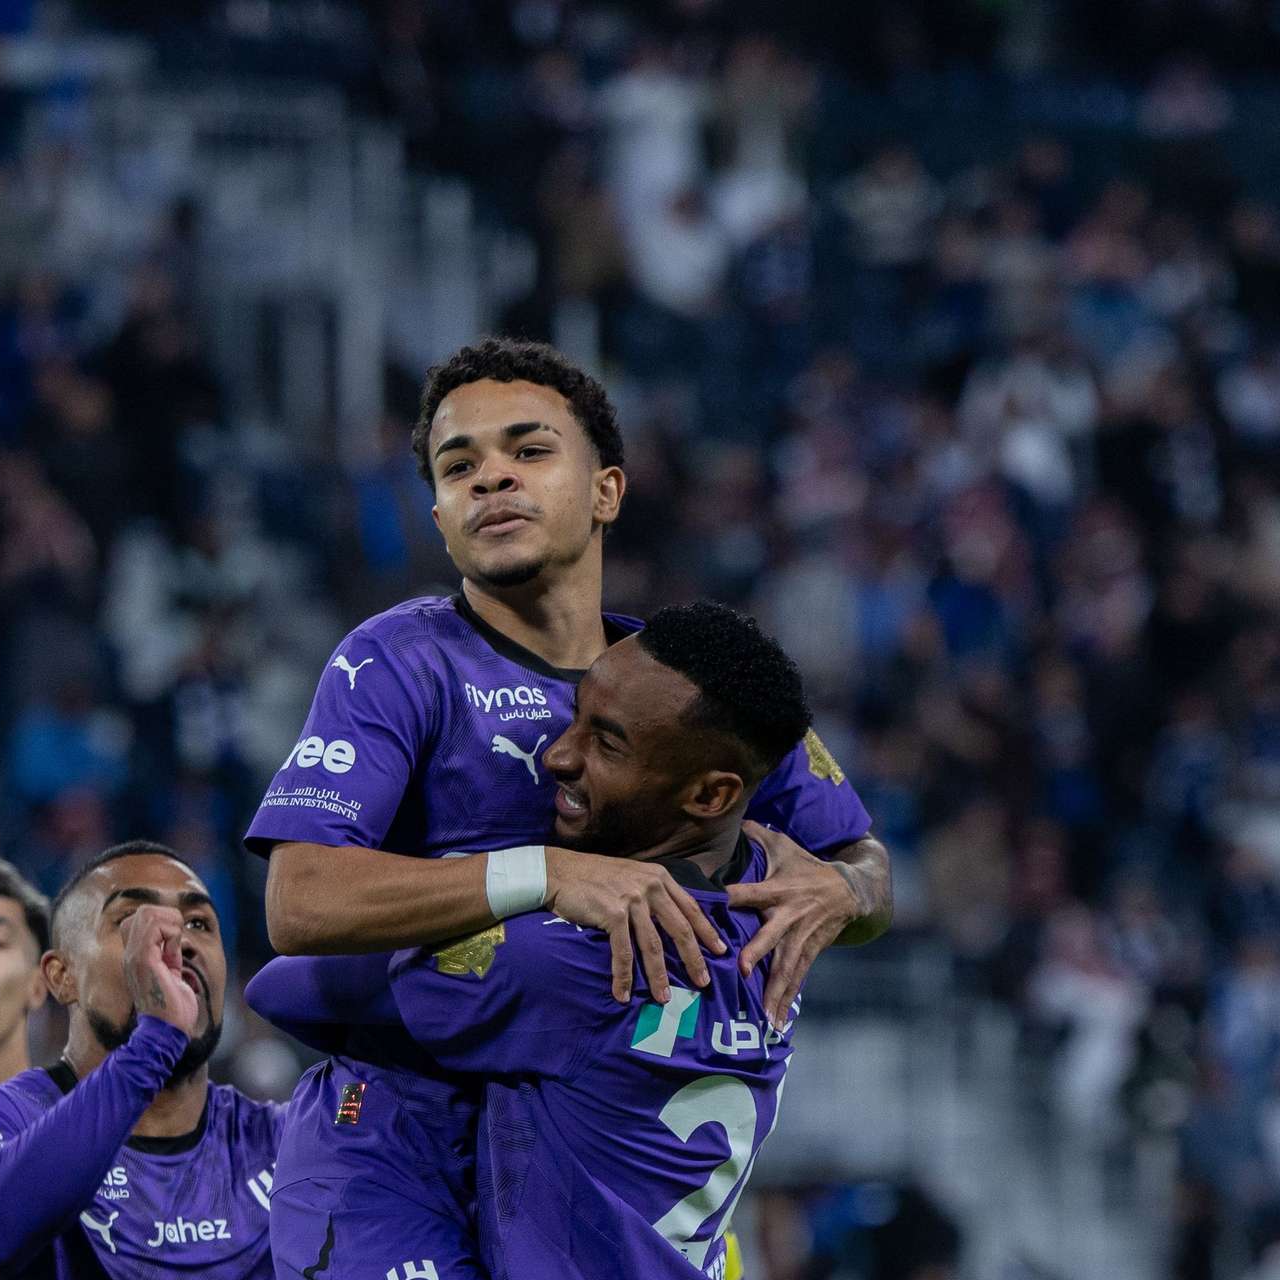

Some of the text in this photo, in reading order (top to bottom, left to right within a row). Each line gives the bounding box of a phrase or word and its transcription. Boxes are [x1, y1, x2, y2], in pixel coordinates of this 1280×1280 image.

[464, 682, 547, 713] flynas
[290, 797, 358, 822] INVESTMENTS
[148, 1216, 232, 1248] Jahez
